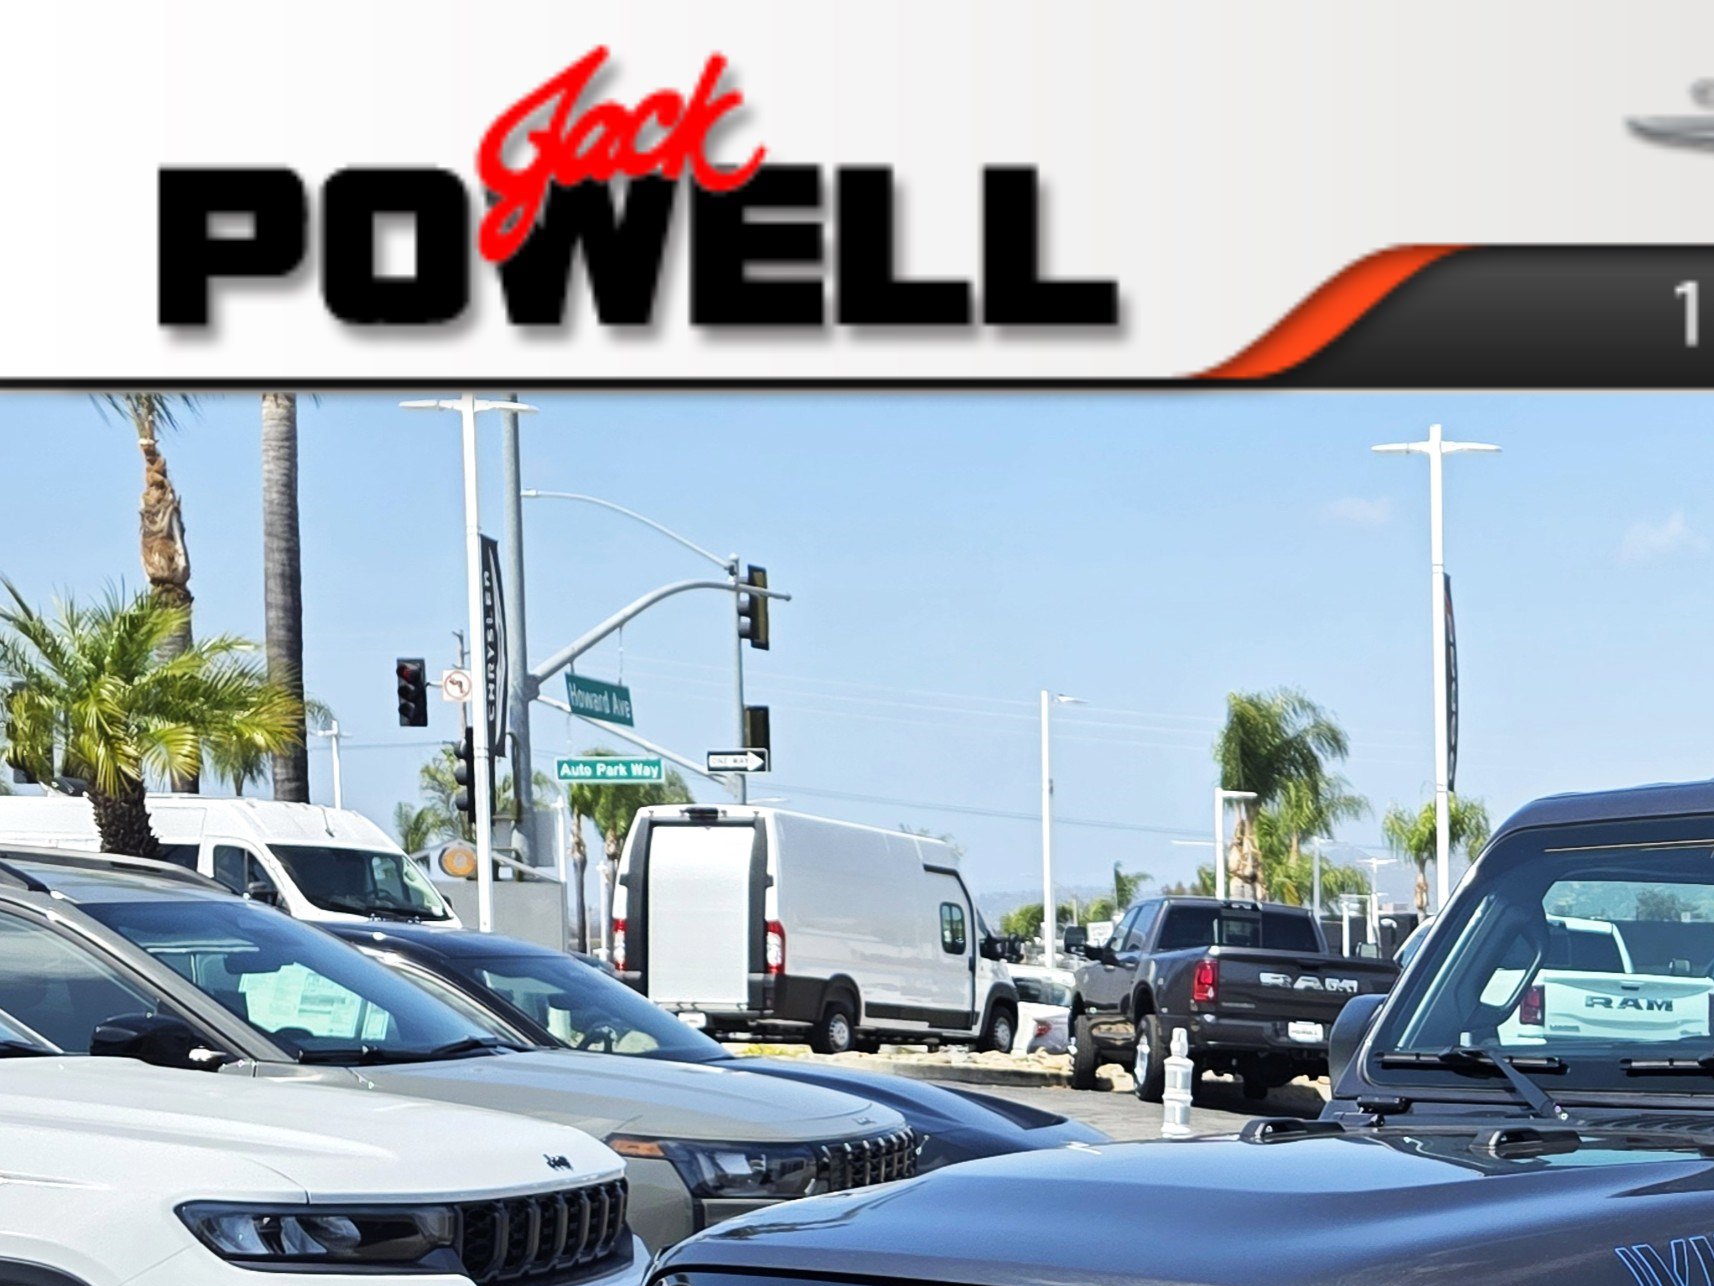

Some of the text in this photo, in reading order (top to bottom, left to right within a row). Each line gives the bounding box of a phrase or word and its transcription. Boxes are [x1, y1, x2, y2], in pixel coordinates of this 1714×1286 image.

[567, 682, 632, 719] Howard Ave
[560, 763, 660, 779] Auto Park Way
[1258, 971, 1359, 993] RAM
[1584, 995, 1674, 1012] RAM
